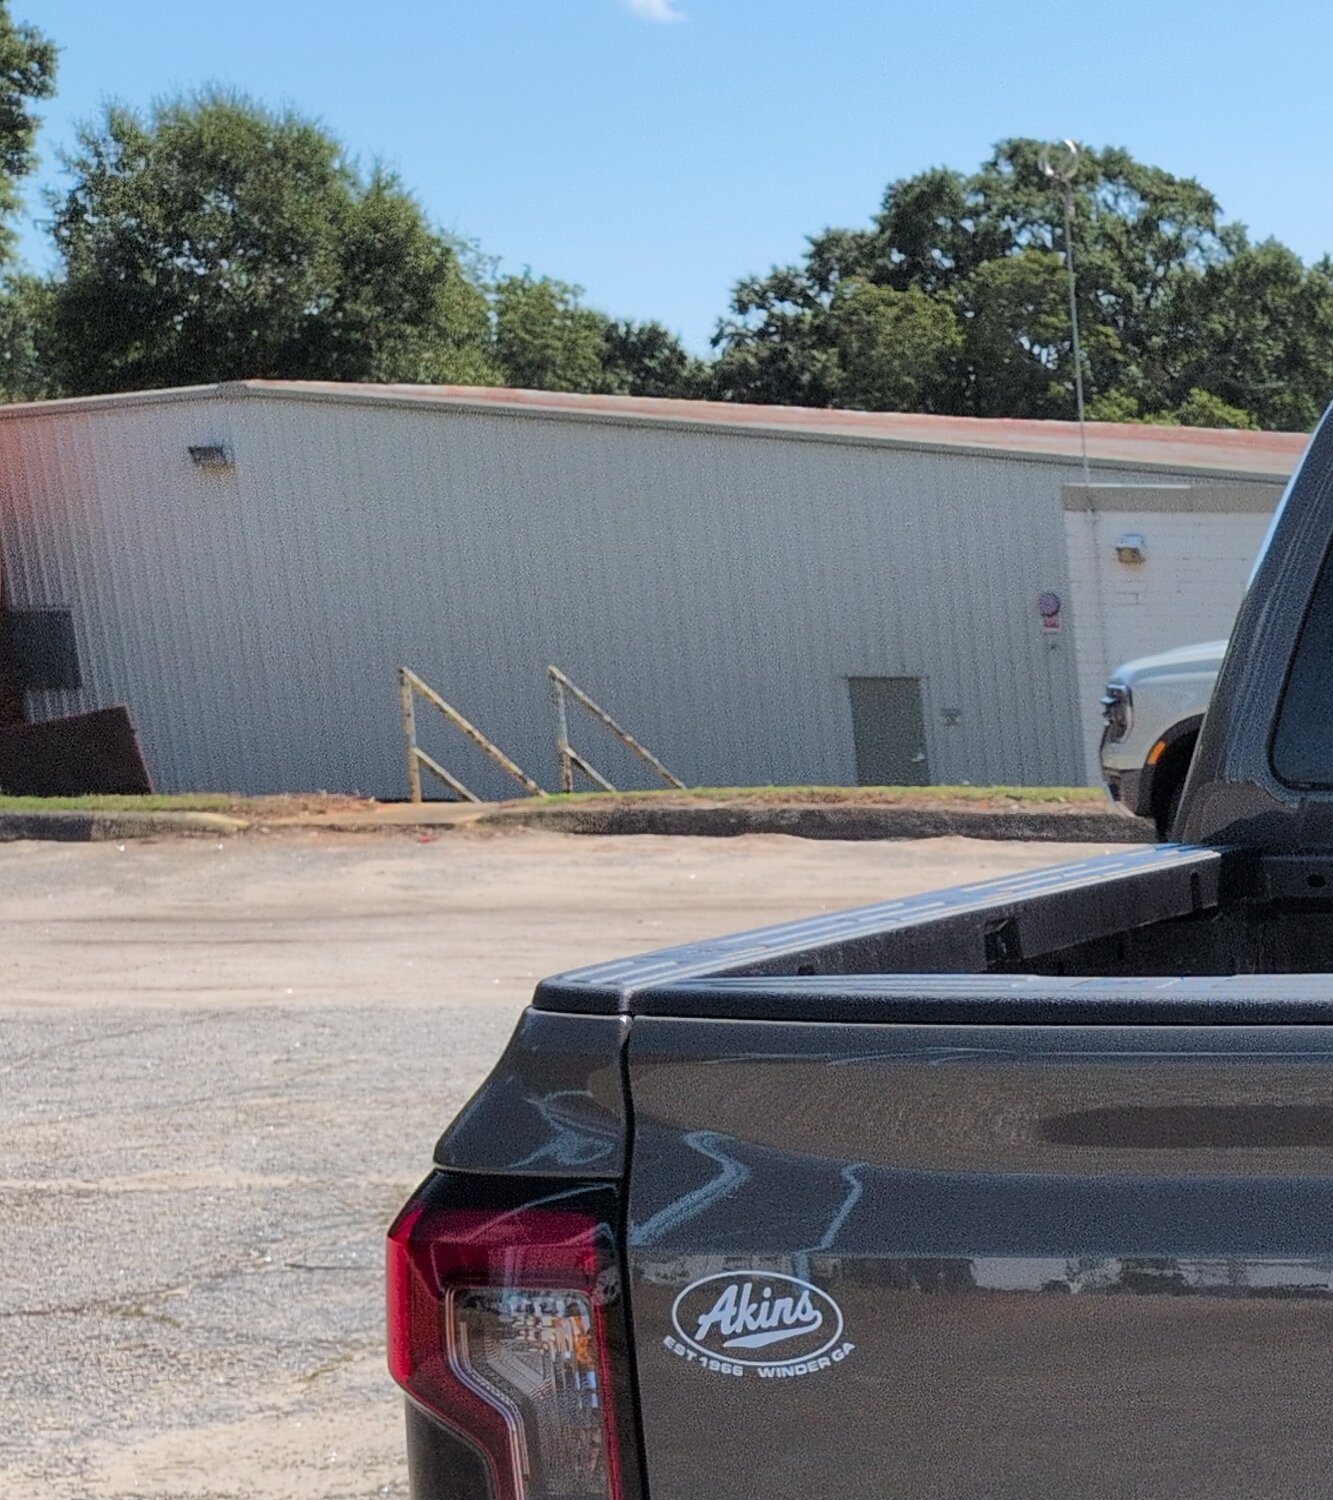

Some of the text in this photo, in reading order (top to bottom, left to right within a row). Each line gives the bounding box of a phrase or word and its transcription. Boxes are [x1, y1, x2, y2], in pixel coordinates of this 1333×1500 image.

[694, 1282, 823, 1348] Akins
[662, 1335, 855, 1379] EST 1966 WINDER GA
